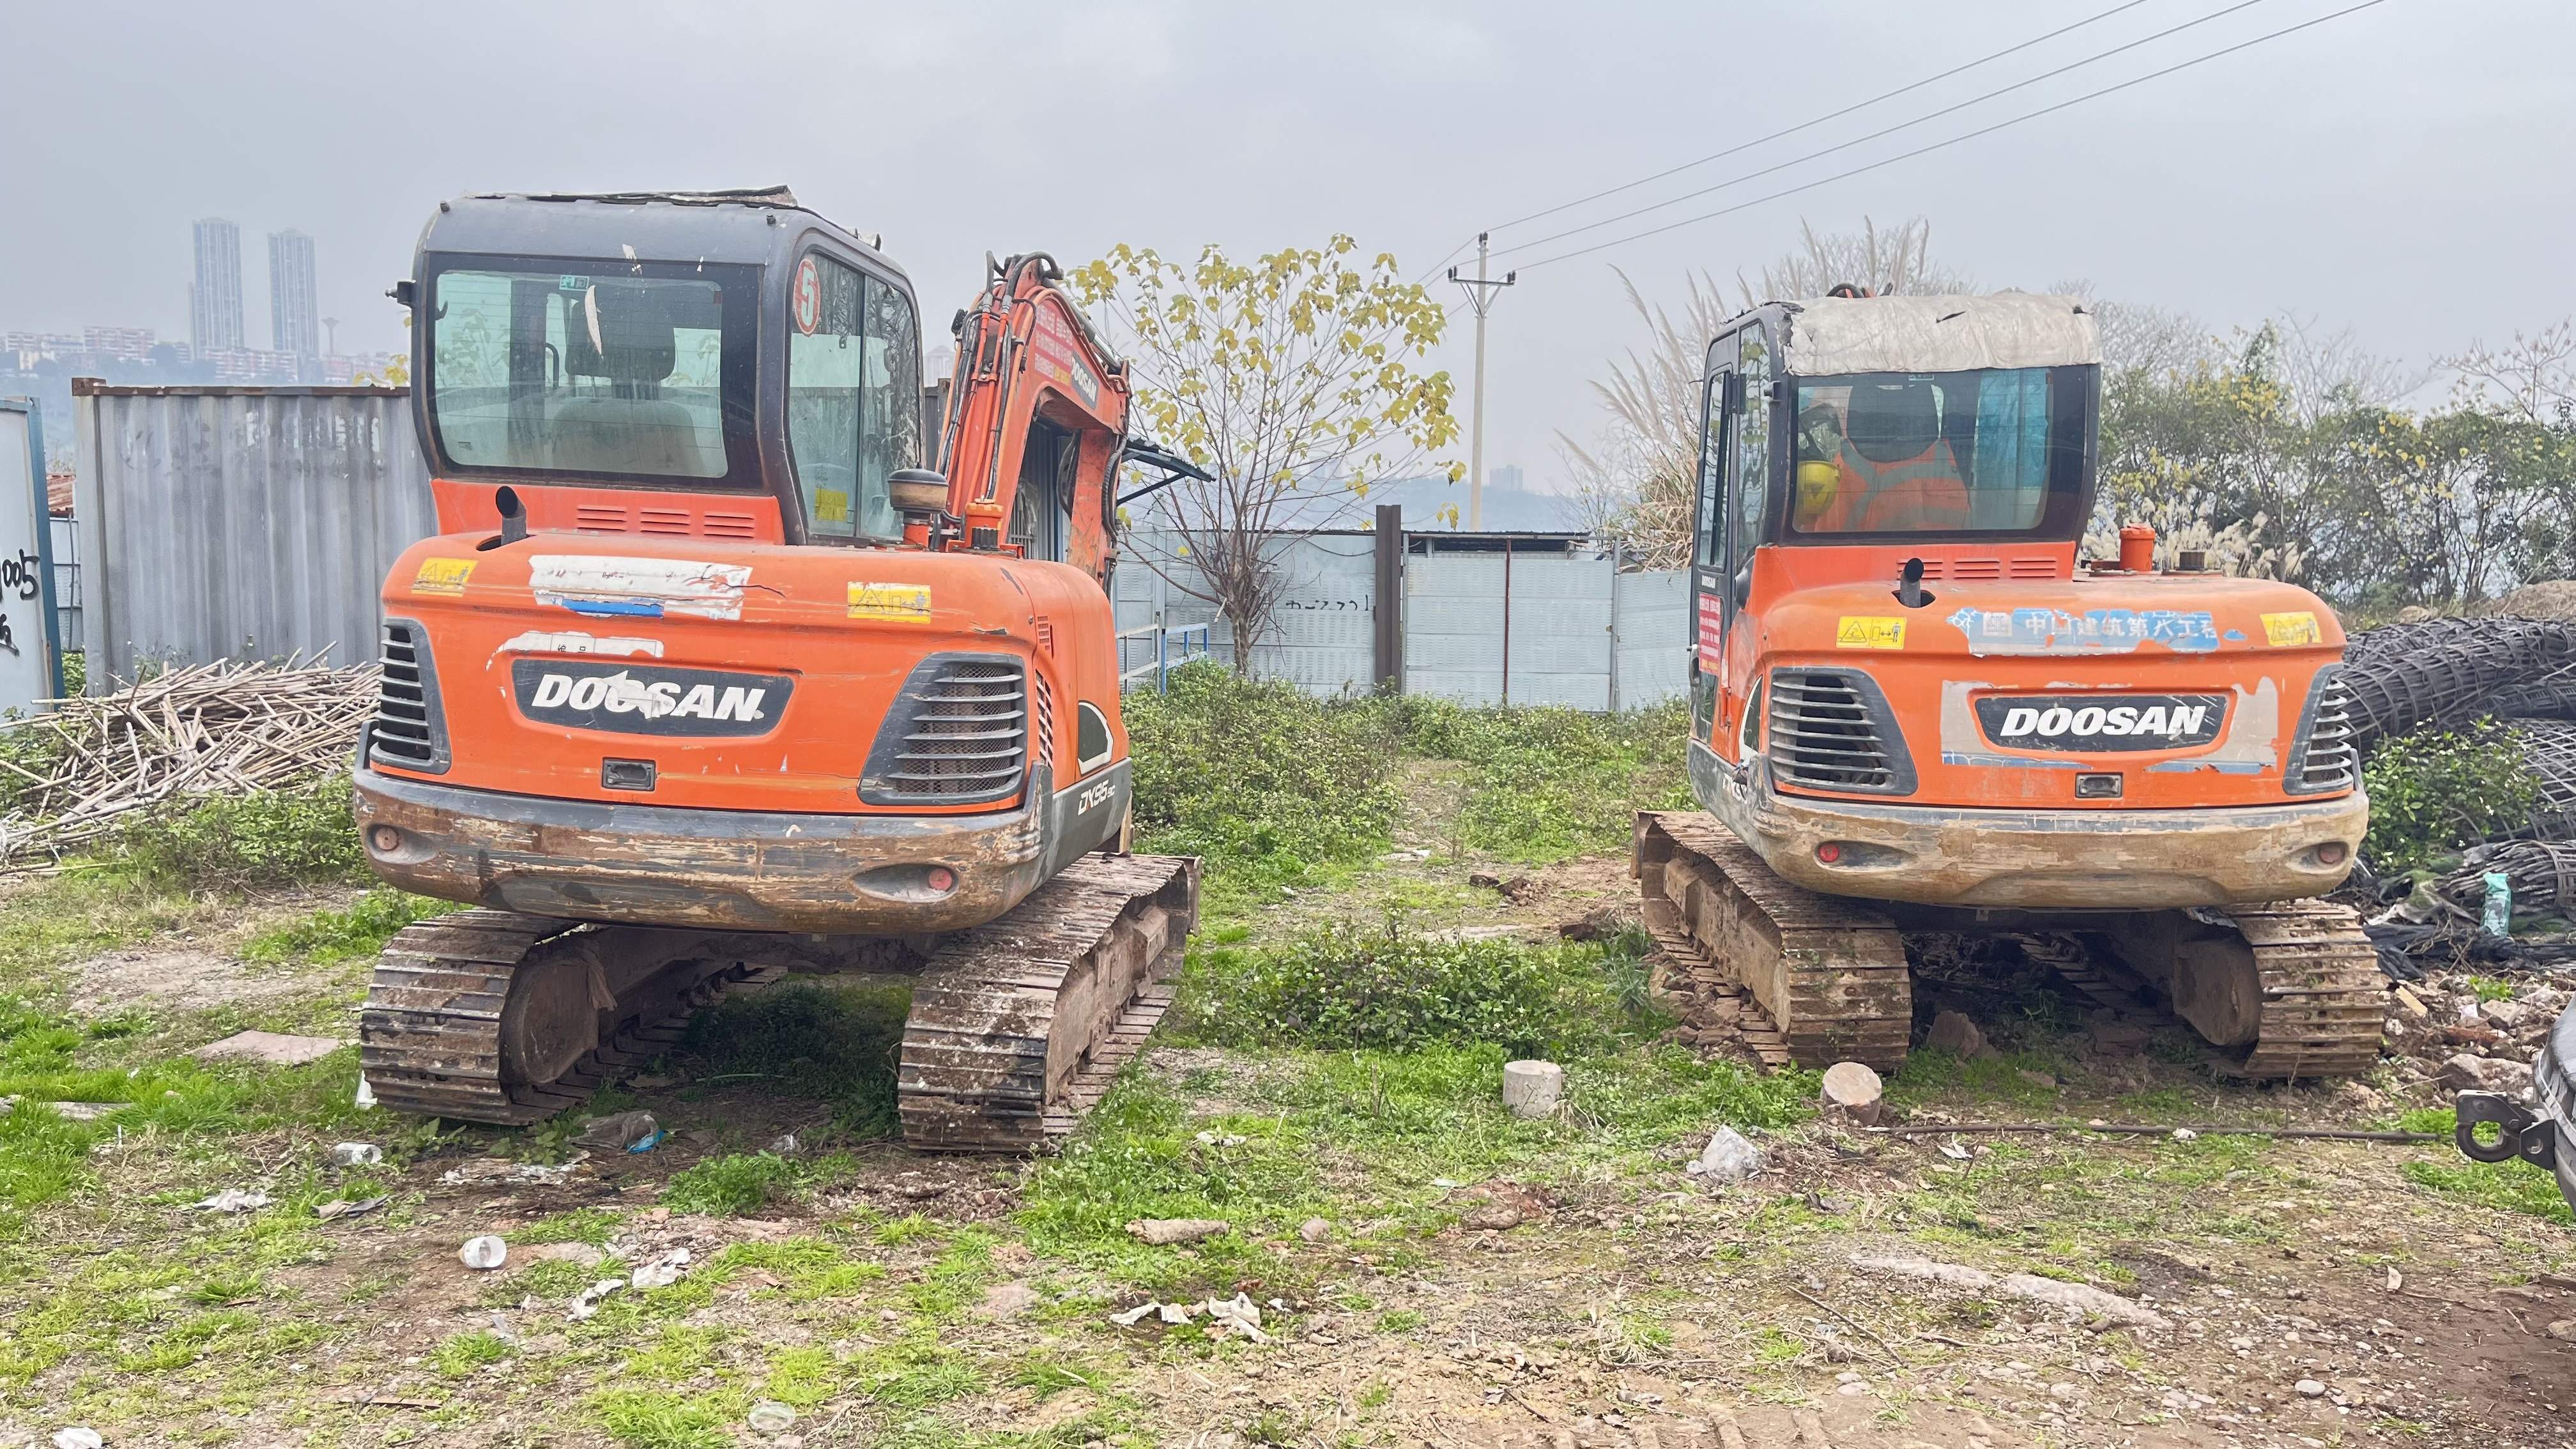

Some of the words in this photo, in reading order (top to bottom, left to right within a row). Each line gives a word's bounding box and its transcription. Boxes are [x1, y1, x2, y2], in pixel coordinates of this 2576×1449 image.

[801, 266, 815, 326] 5
[0, 548, 40, 601] 005
[532, 673, 766, 722] DOOSAN
[2000, 705, 2206, 737] DOOSAN
